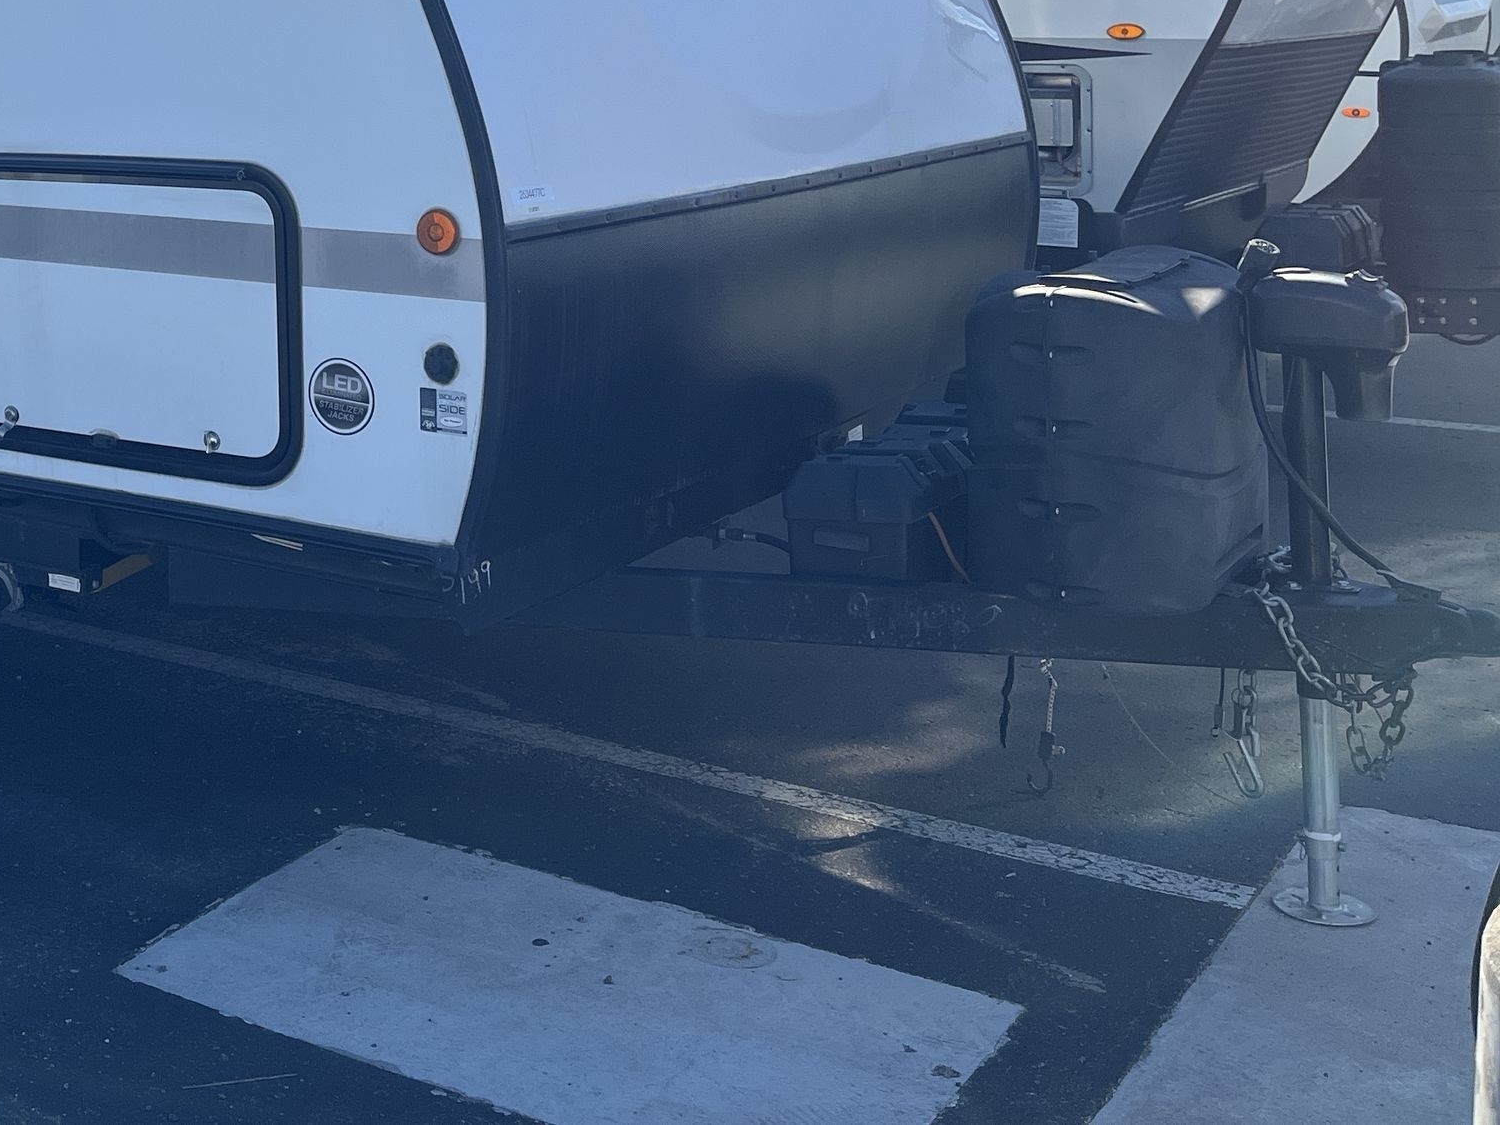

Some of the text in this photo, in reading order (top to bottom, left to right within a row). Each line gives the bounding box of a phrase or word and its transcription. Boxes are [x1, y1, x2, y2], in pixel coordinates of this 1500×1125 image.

[322, 371, 363, 394] LED
[438, 393, 466, 403] SOLAR
[319, 400, 365, 416] STABILIZER
[438, 404, 467, 416] SIDE
[327, 410, 355, 422] JACKS
